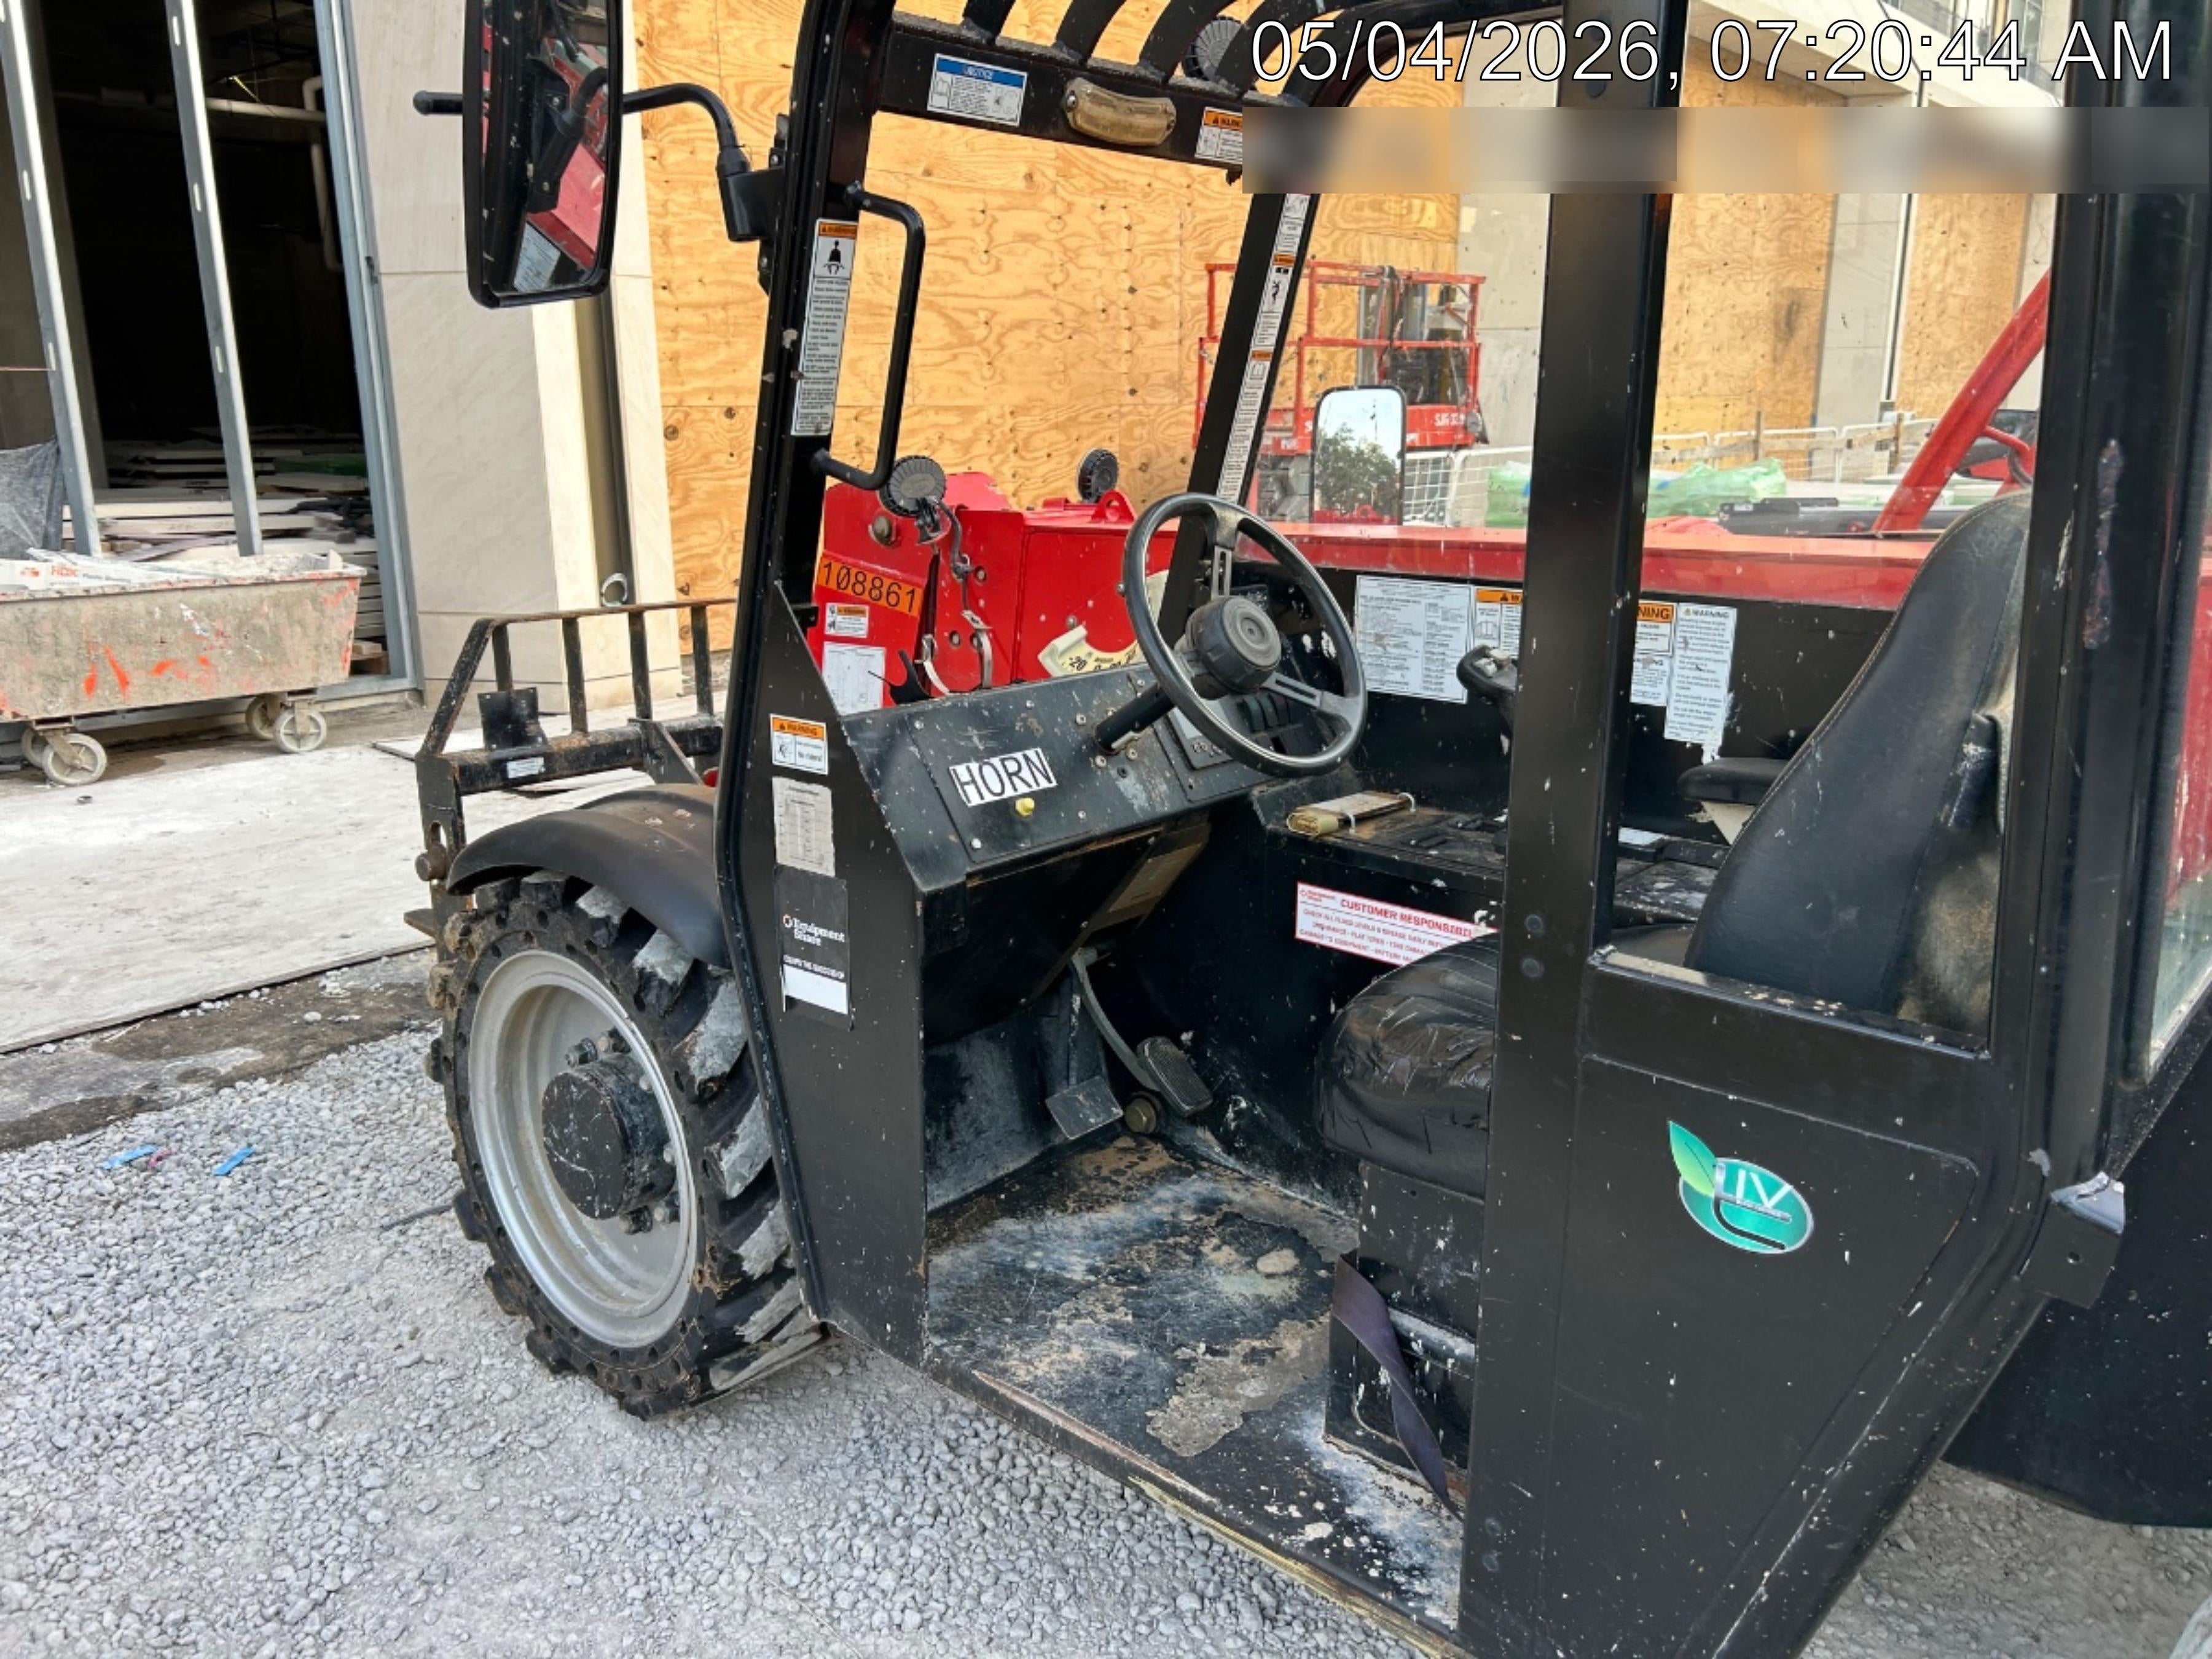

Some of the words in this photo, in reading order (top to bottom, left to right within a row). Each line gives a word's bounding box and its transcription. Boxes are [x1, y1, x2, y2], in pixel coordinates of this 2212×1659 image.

[823, 562, 916, 613] 108861
[952, 750, 1053, 804] HORN
[1341, 898, 1397, 920] CUSTOMER
[793, 917, 845, 942] Equipment
